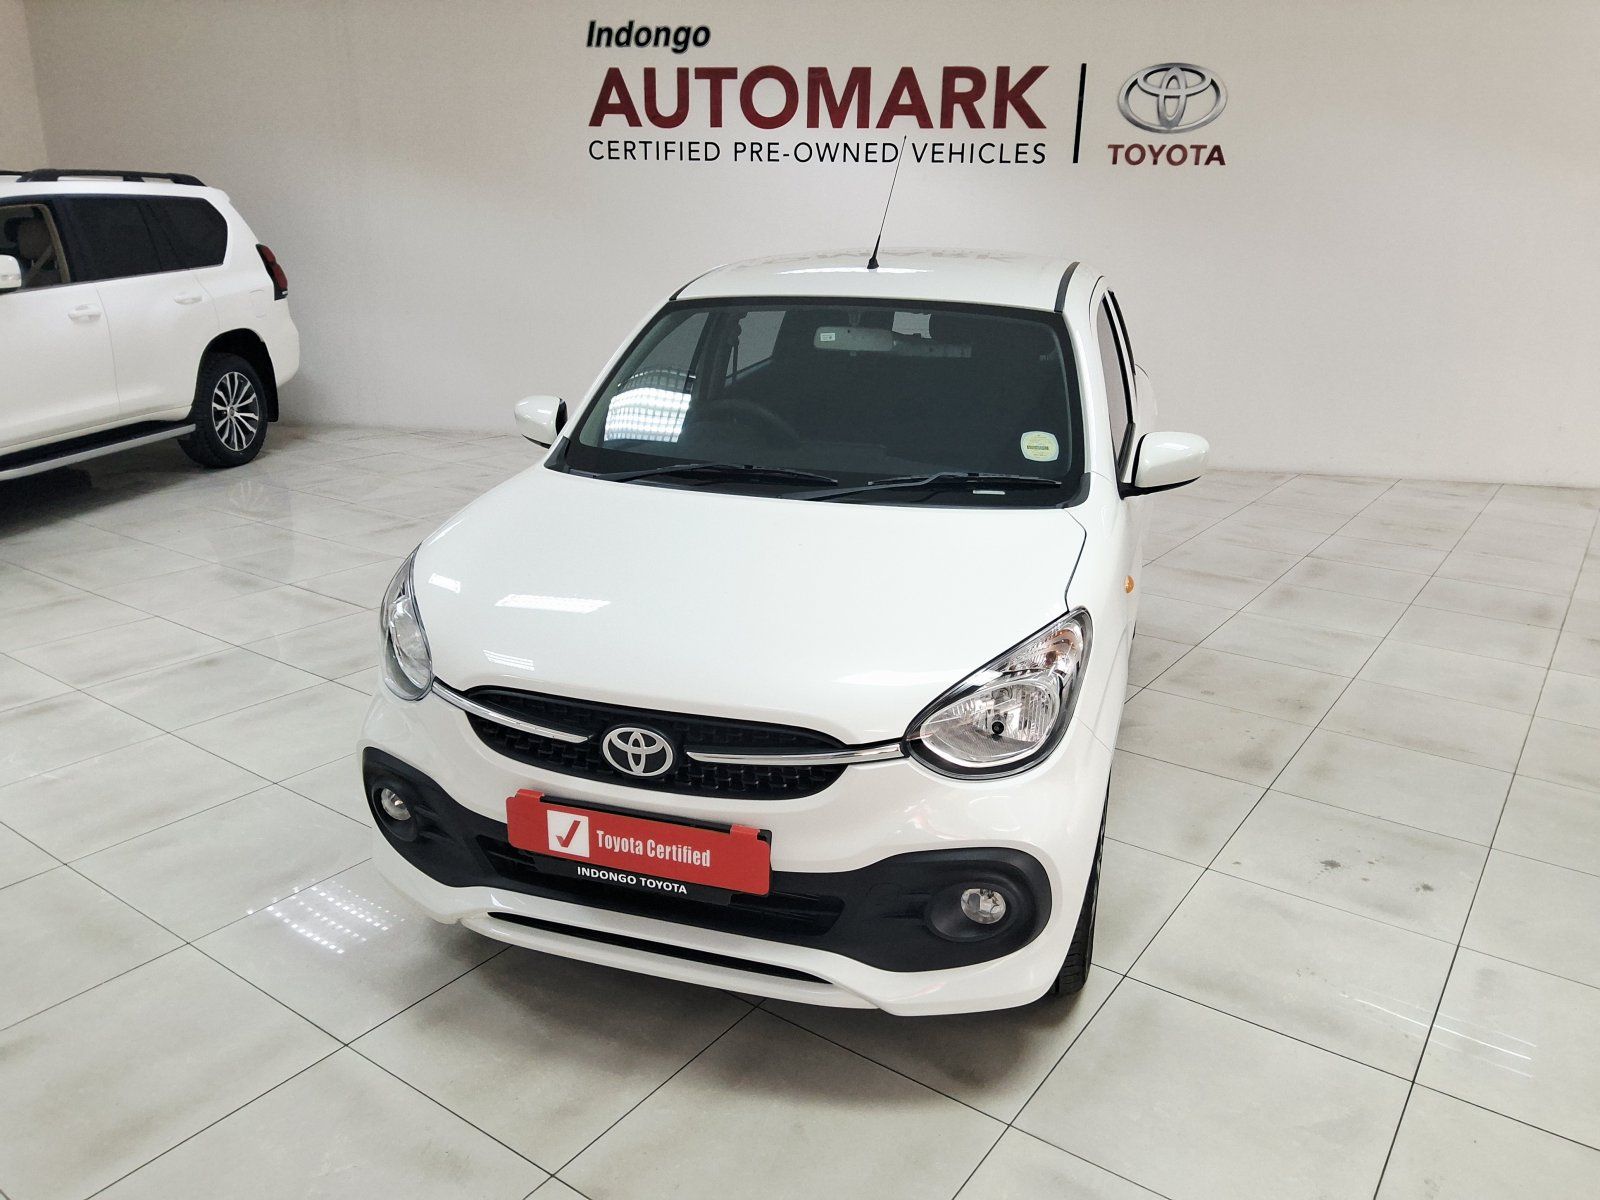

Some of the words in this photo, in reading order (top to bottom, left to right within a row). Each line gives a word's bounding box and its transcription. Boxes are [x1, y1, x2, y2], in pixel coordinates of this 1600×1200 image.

[586, 20, 711, 54] Indongo
[588, 65, 1050, 130] AUTOMARK
[588, 140, 721, 162] CERTIFIED
[733, 141, 899, 164] PRE-OWNED
[910, 142, 1046, 165] VEHICLES
[1107, 143, 1227, 167] TOYOTA
[596, 829, 643, 855] Toyota
[646, 839, 711, 868] Certified
[577, 866, 637, 885] INDONGO
[639, 877, 688, 895] TOYOTA
